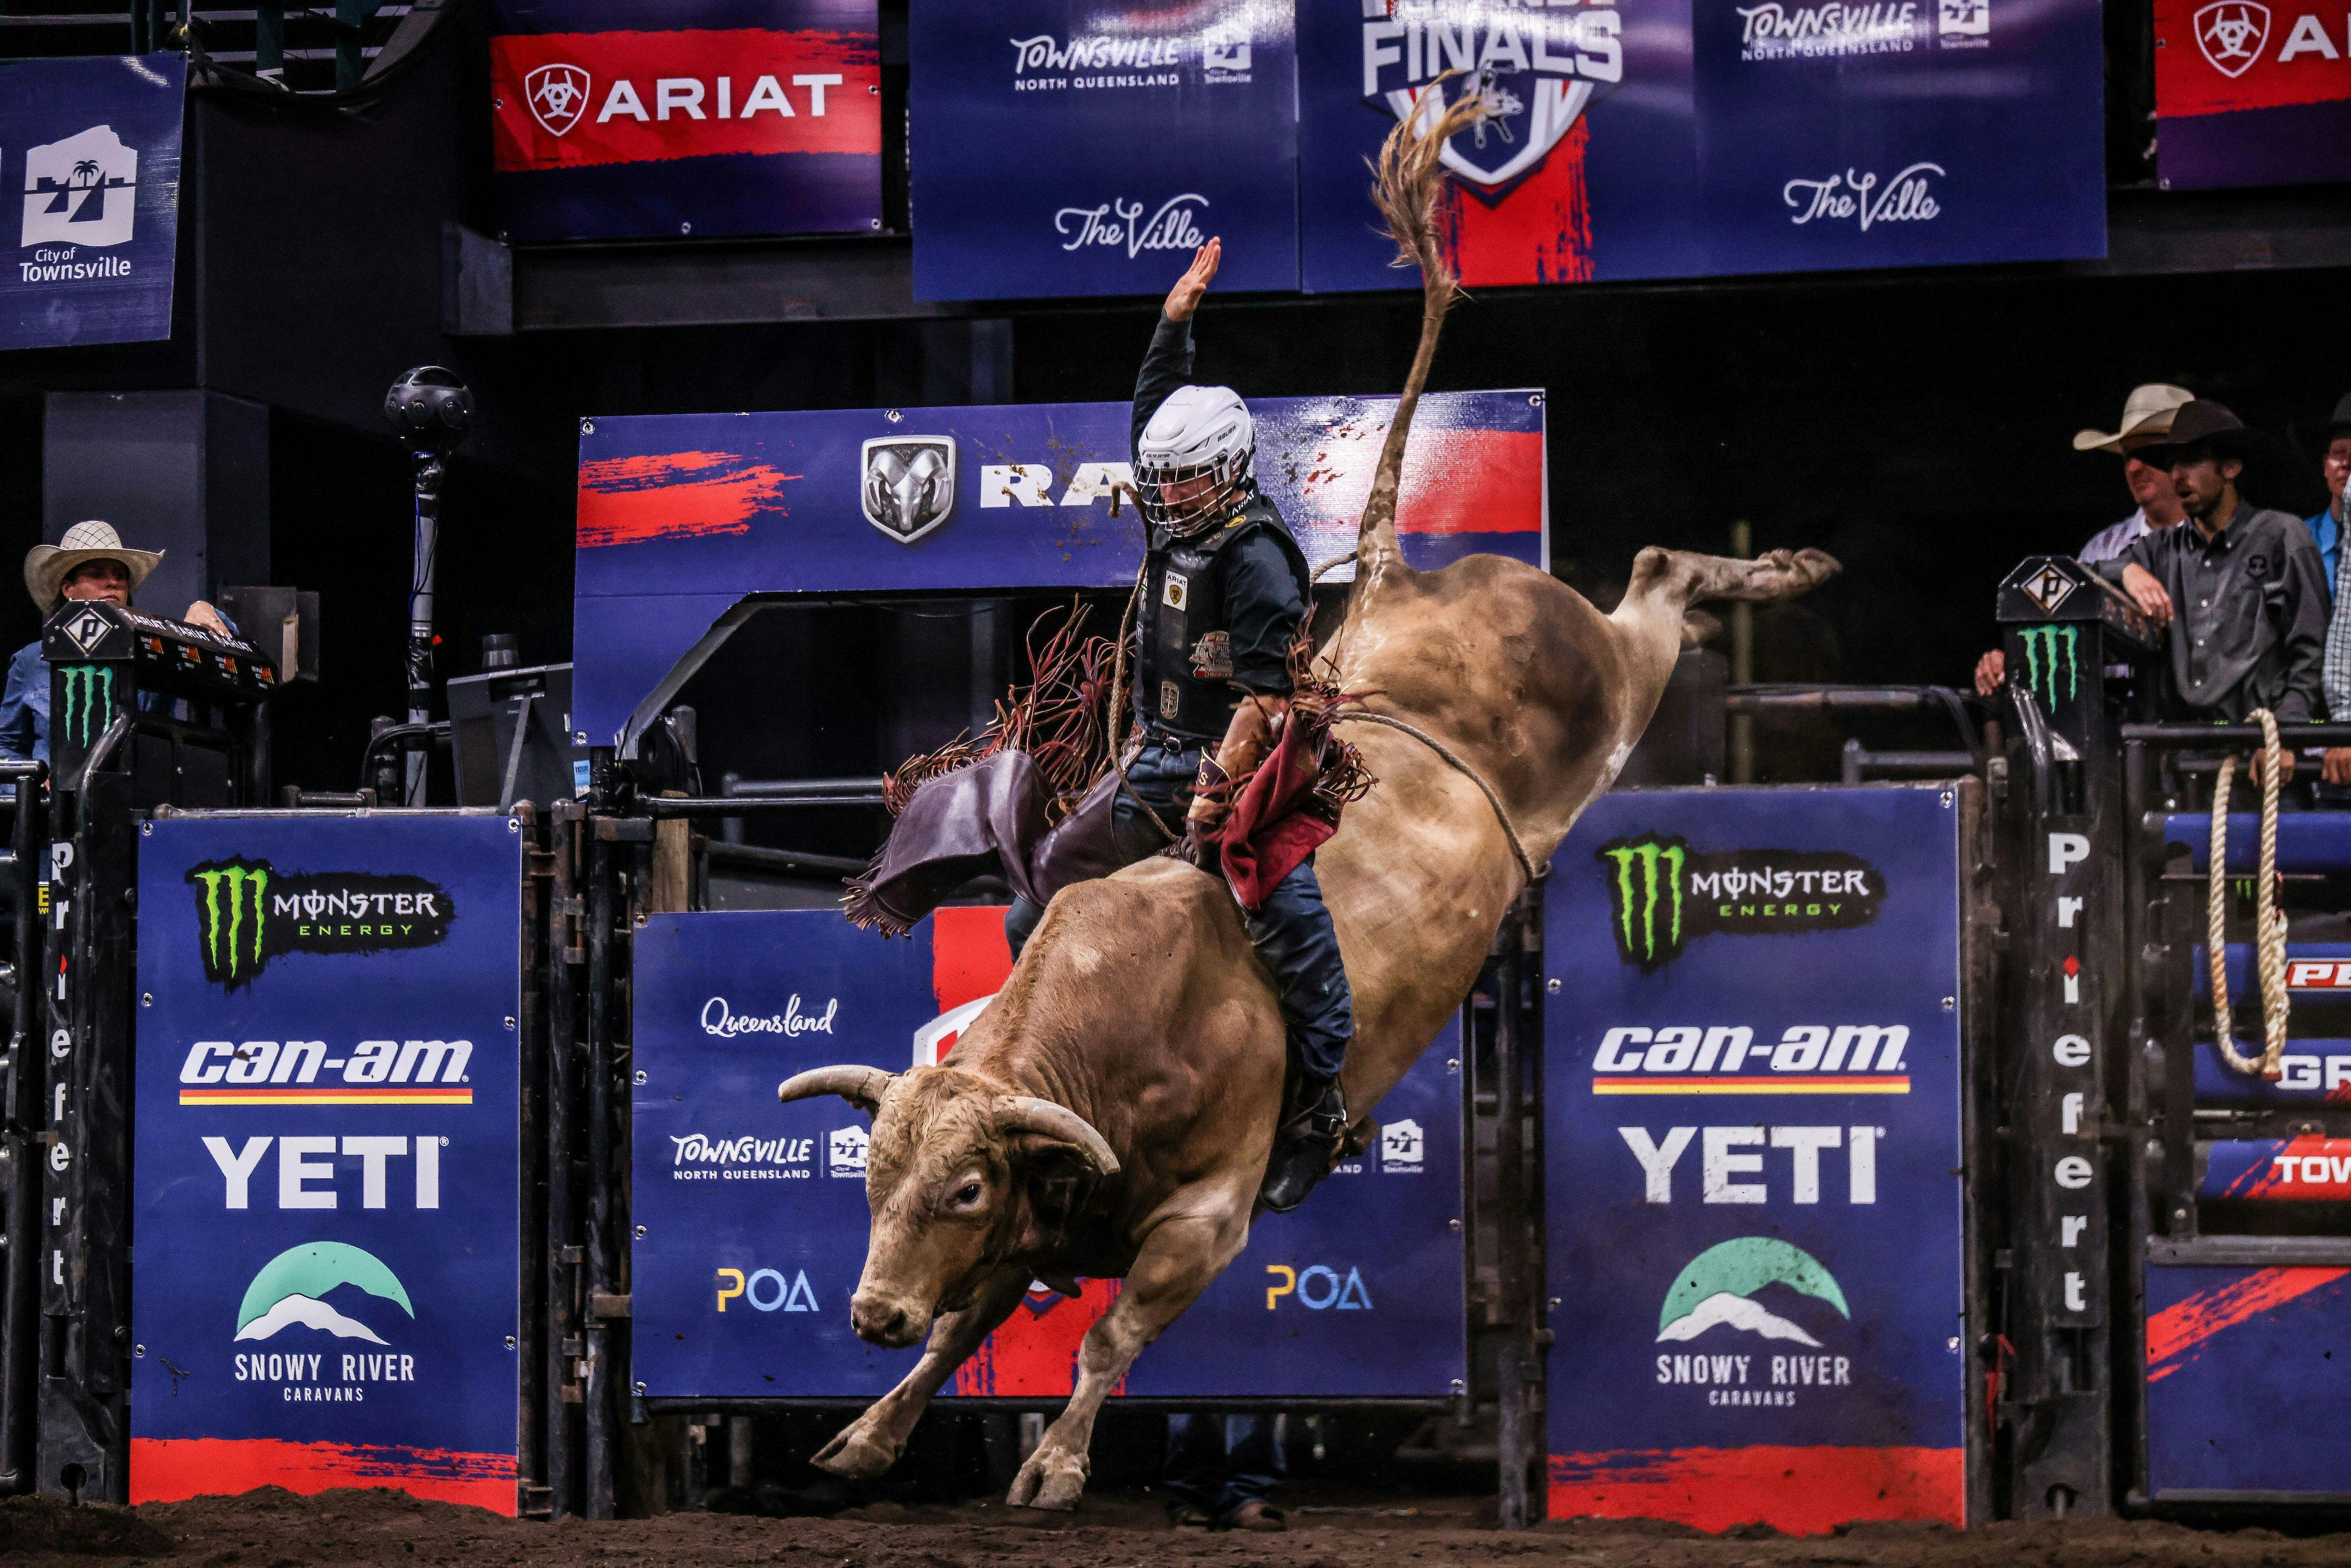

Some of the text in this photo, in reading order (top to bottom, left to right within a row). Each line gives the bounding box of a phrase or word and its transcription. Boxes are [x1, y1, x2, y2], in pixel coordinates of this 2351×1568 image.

[1736, 1, 1916, 44] TOWNSVILLE
[2277, 14, 2351, 62] A
[1009, 34, 1182, 74] TOWNSVILLE
[1363, 10, 1623, 97] FINALS
[597, 73, 842, 123] ARIAT
[1015, 74, 1179, 91] NORTH QUEENSLAND
[1783, 162, 1946, 231] The Ville
[1055, 193, 1209, 259] The Ville
[20, 256, 131, 283] Townsville
[35, 247, 75, 264] City of
[981, 461, 1139, 508] RA
[1232, 489, 1254, 516] ARIAT
[1167, 574, 1186, 586] ARIAT
[133, 614, 167, 630] ARIAT
[178, 625, 211, 641] ARIAT
[1692, 866, 1870, 900] MONSTER
[273, 889, 439, 920] MONSTER
[1719, 903, 1842, 917] ENERGY
[300, 925, 413, 936] ENERGY
[701, 994, 838, 1038] Queensland
[51, 842, 74, 1285] Priefert
[2048, 832, 2093, 1312] Priefert
[670, 1134, 814, 1165] TOWNSVILLE
[674, 1169, 811, 1180] NORTH QUEENSLAND
[831, 1170, 865, 1178] Townsvill
[717, 1268, 819, 1312] POA
[1267, 1265, 1374, 1310] POA
[235, 1354, 414, 1381] SNOWY RIVER
[1656, 1354, 1850, 1386] SNOWY RIVER
[284, 1387, 363, 1402] CARAVANS
[1709, 1390, 1796, 1406] CARAVANS
